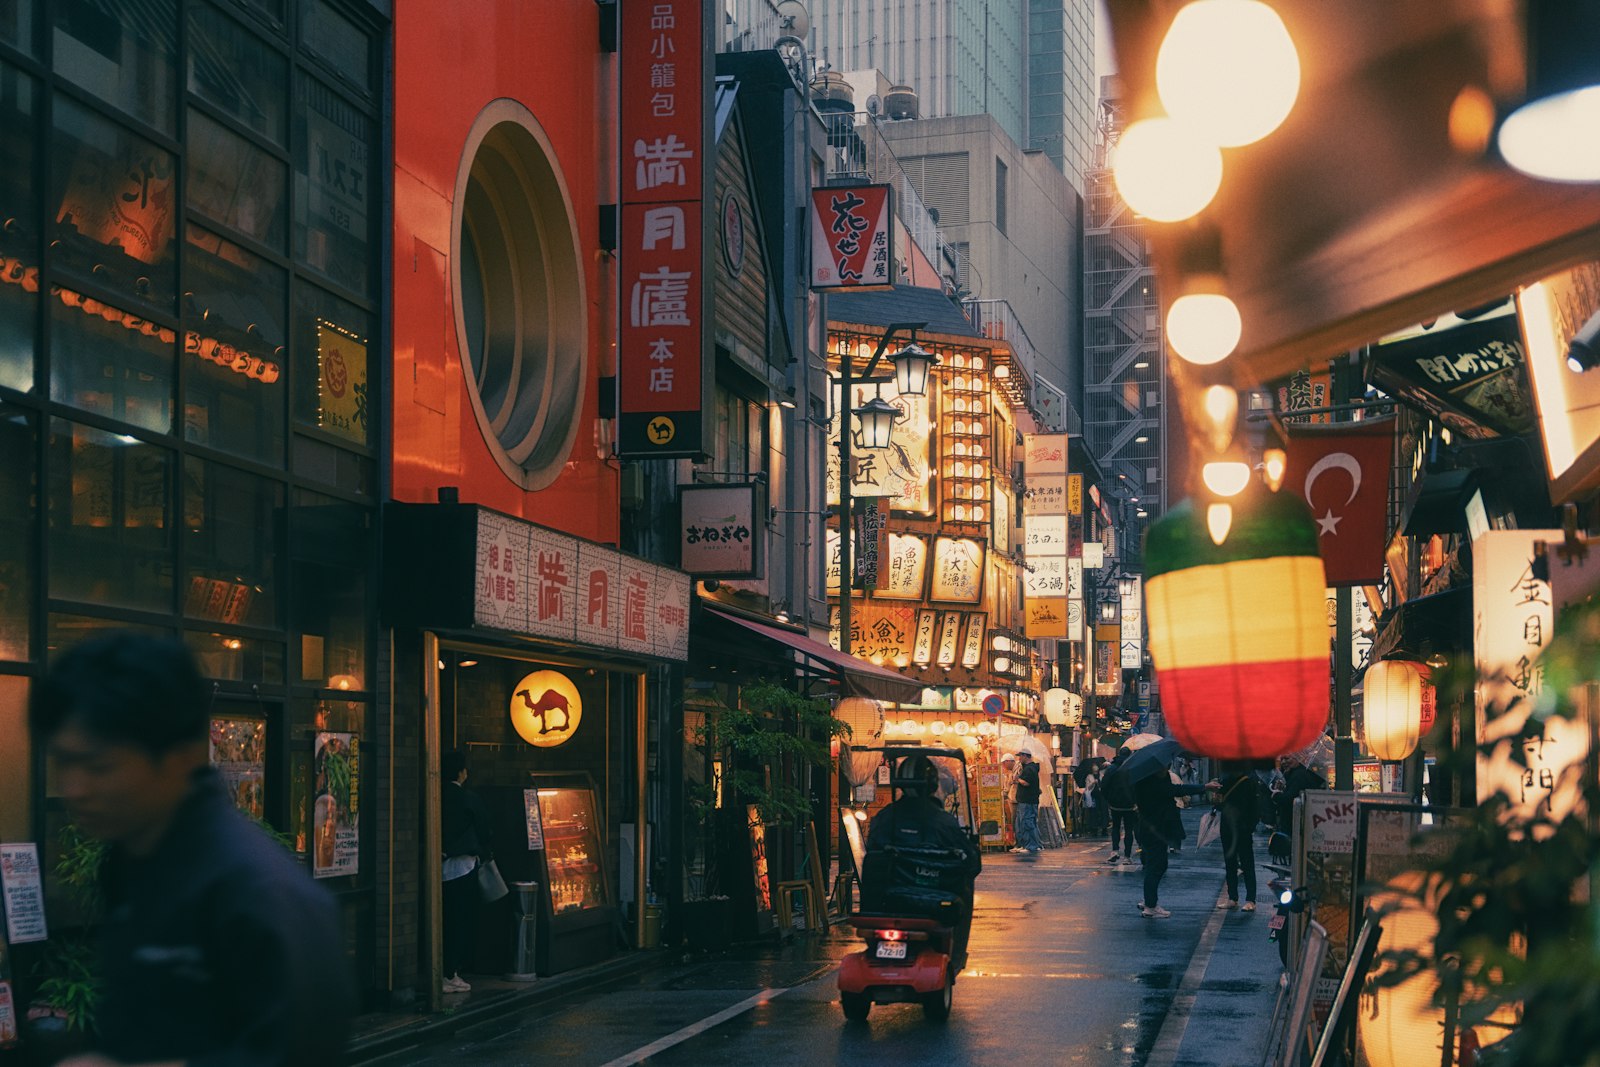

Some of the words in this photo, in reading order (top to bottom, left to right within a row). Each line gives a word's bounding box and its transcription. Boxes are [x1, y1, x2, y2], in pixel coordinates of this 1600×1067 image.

[650, 3, 676, 117] 品小籠包
[831, 191, 869, 281] 花ぜん
[873, 231, 887, 278] 居酒屋
[649, 338, 675, 393] 本店
[686, 524, 749, 545] おねぎや
[864, 503, 879, 586] 末広通り商店会
[485, 572, 516, 603] 小籠包
[903, 547, 917, 587] 魚河岸
[946, 557, 962, 588] 大漁
[918, 615, 931, 660] カマ焼き
[943, 616, 956, 661] 本まぐろ
[1141, 684, 1148, 693] P
